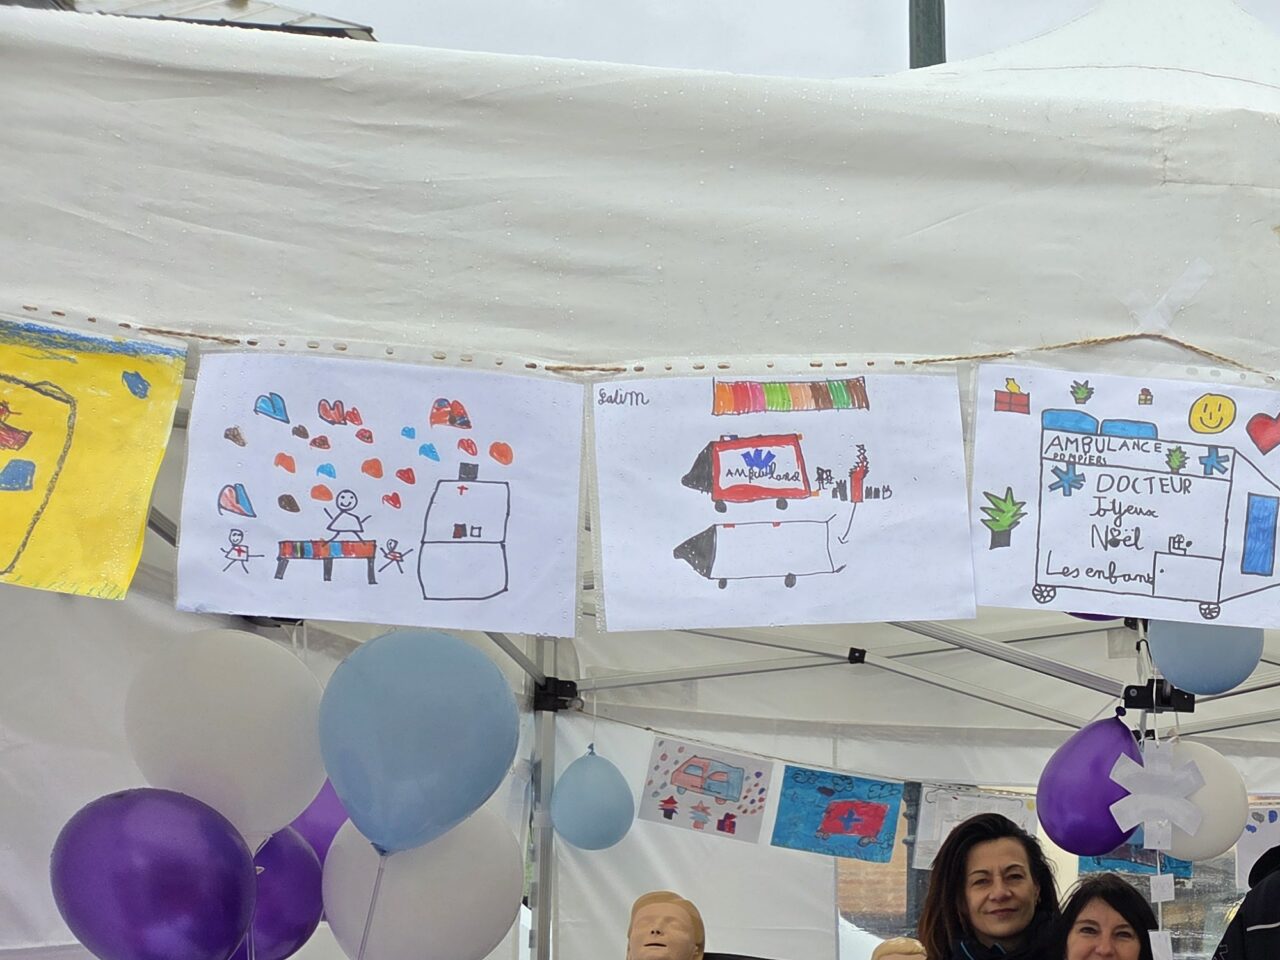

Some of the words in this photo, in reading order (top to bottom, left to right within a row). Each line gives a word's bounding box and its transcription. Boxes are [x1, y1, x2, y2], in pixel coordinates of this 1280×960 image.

[1044, 435, 1163, 455] AMBULANCE
[1096, 474, 1192, 495] DOCTEUR
[1046, 550, 1081, 579] Les
